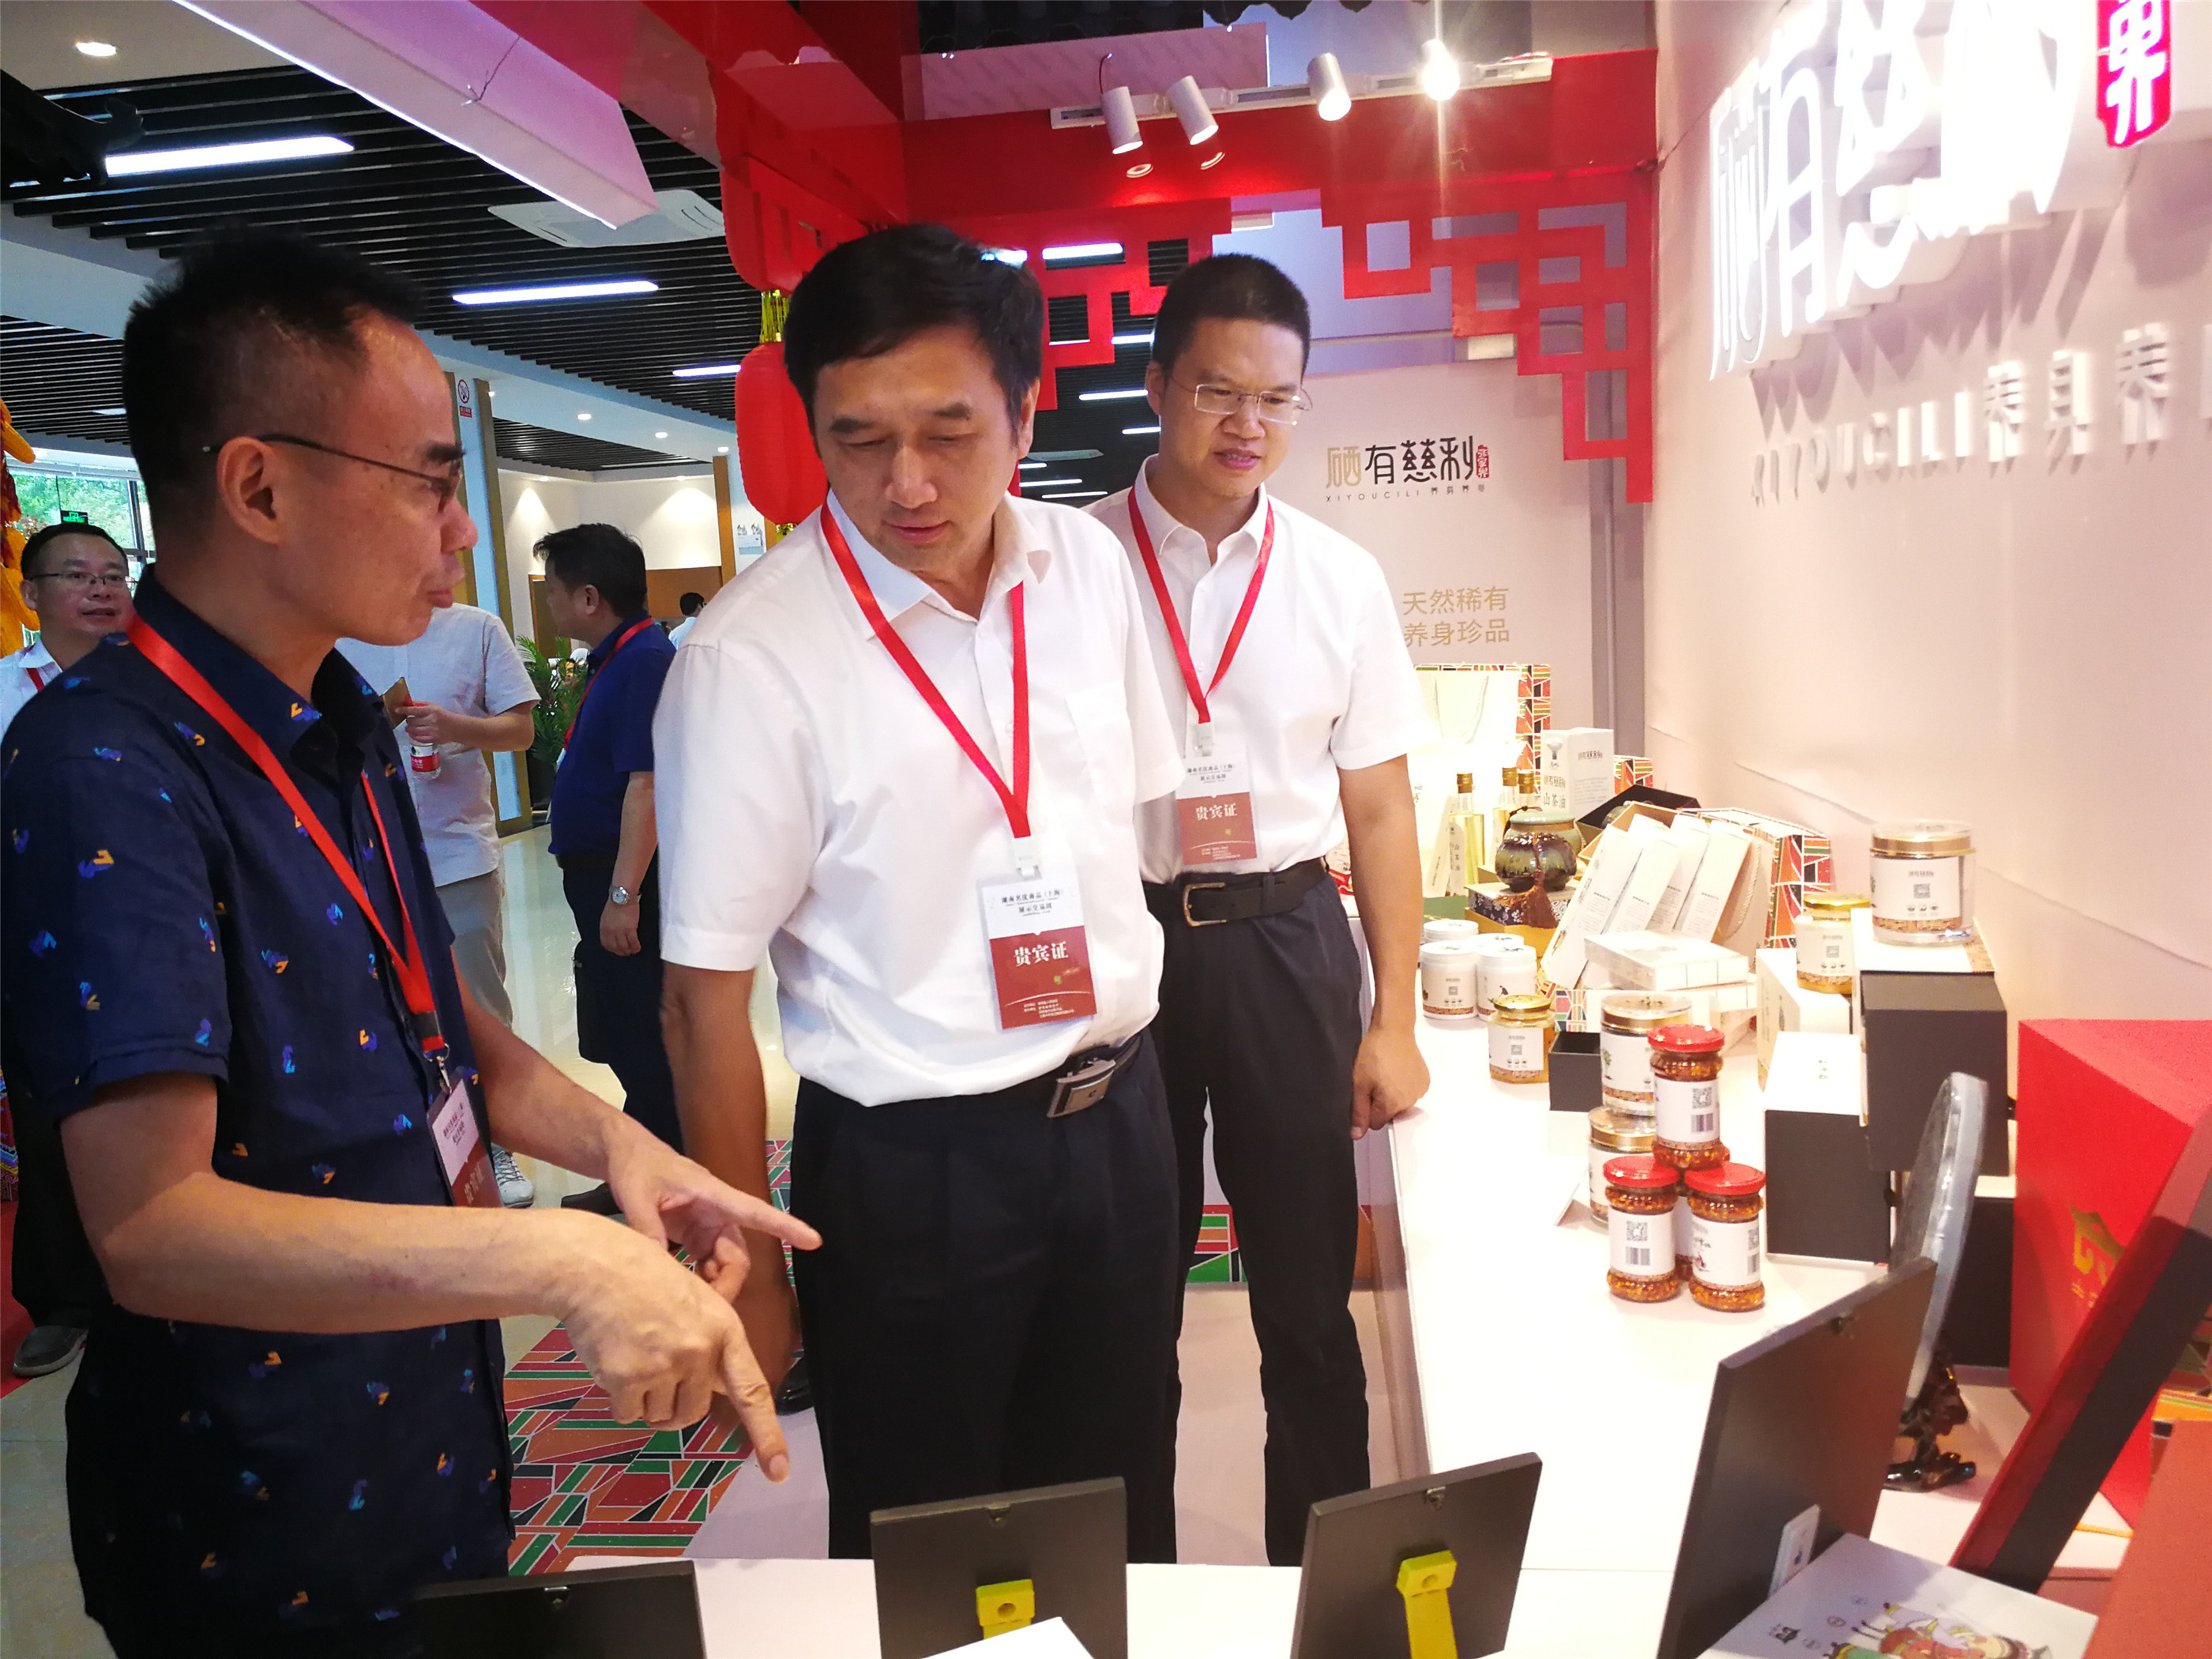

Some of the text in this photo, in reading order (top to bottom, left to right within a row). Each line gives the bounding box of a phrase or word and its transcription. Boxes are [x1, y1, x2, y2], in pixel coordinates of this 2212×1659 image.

[1982, 322, 2212, 463] 养身养
[1326, 435, 1473, 488] 硒有慈利
[1326, 489, 1419, 503] XIYOUCILI
[1402, 586, 1510, 615] 天然稀有
[1404, 618, 1510, 649] 养身珍品
[1195, 803, 1238, 822] 贵宾证
[1013, 941, 1069, 967] 贵宾证
